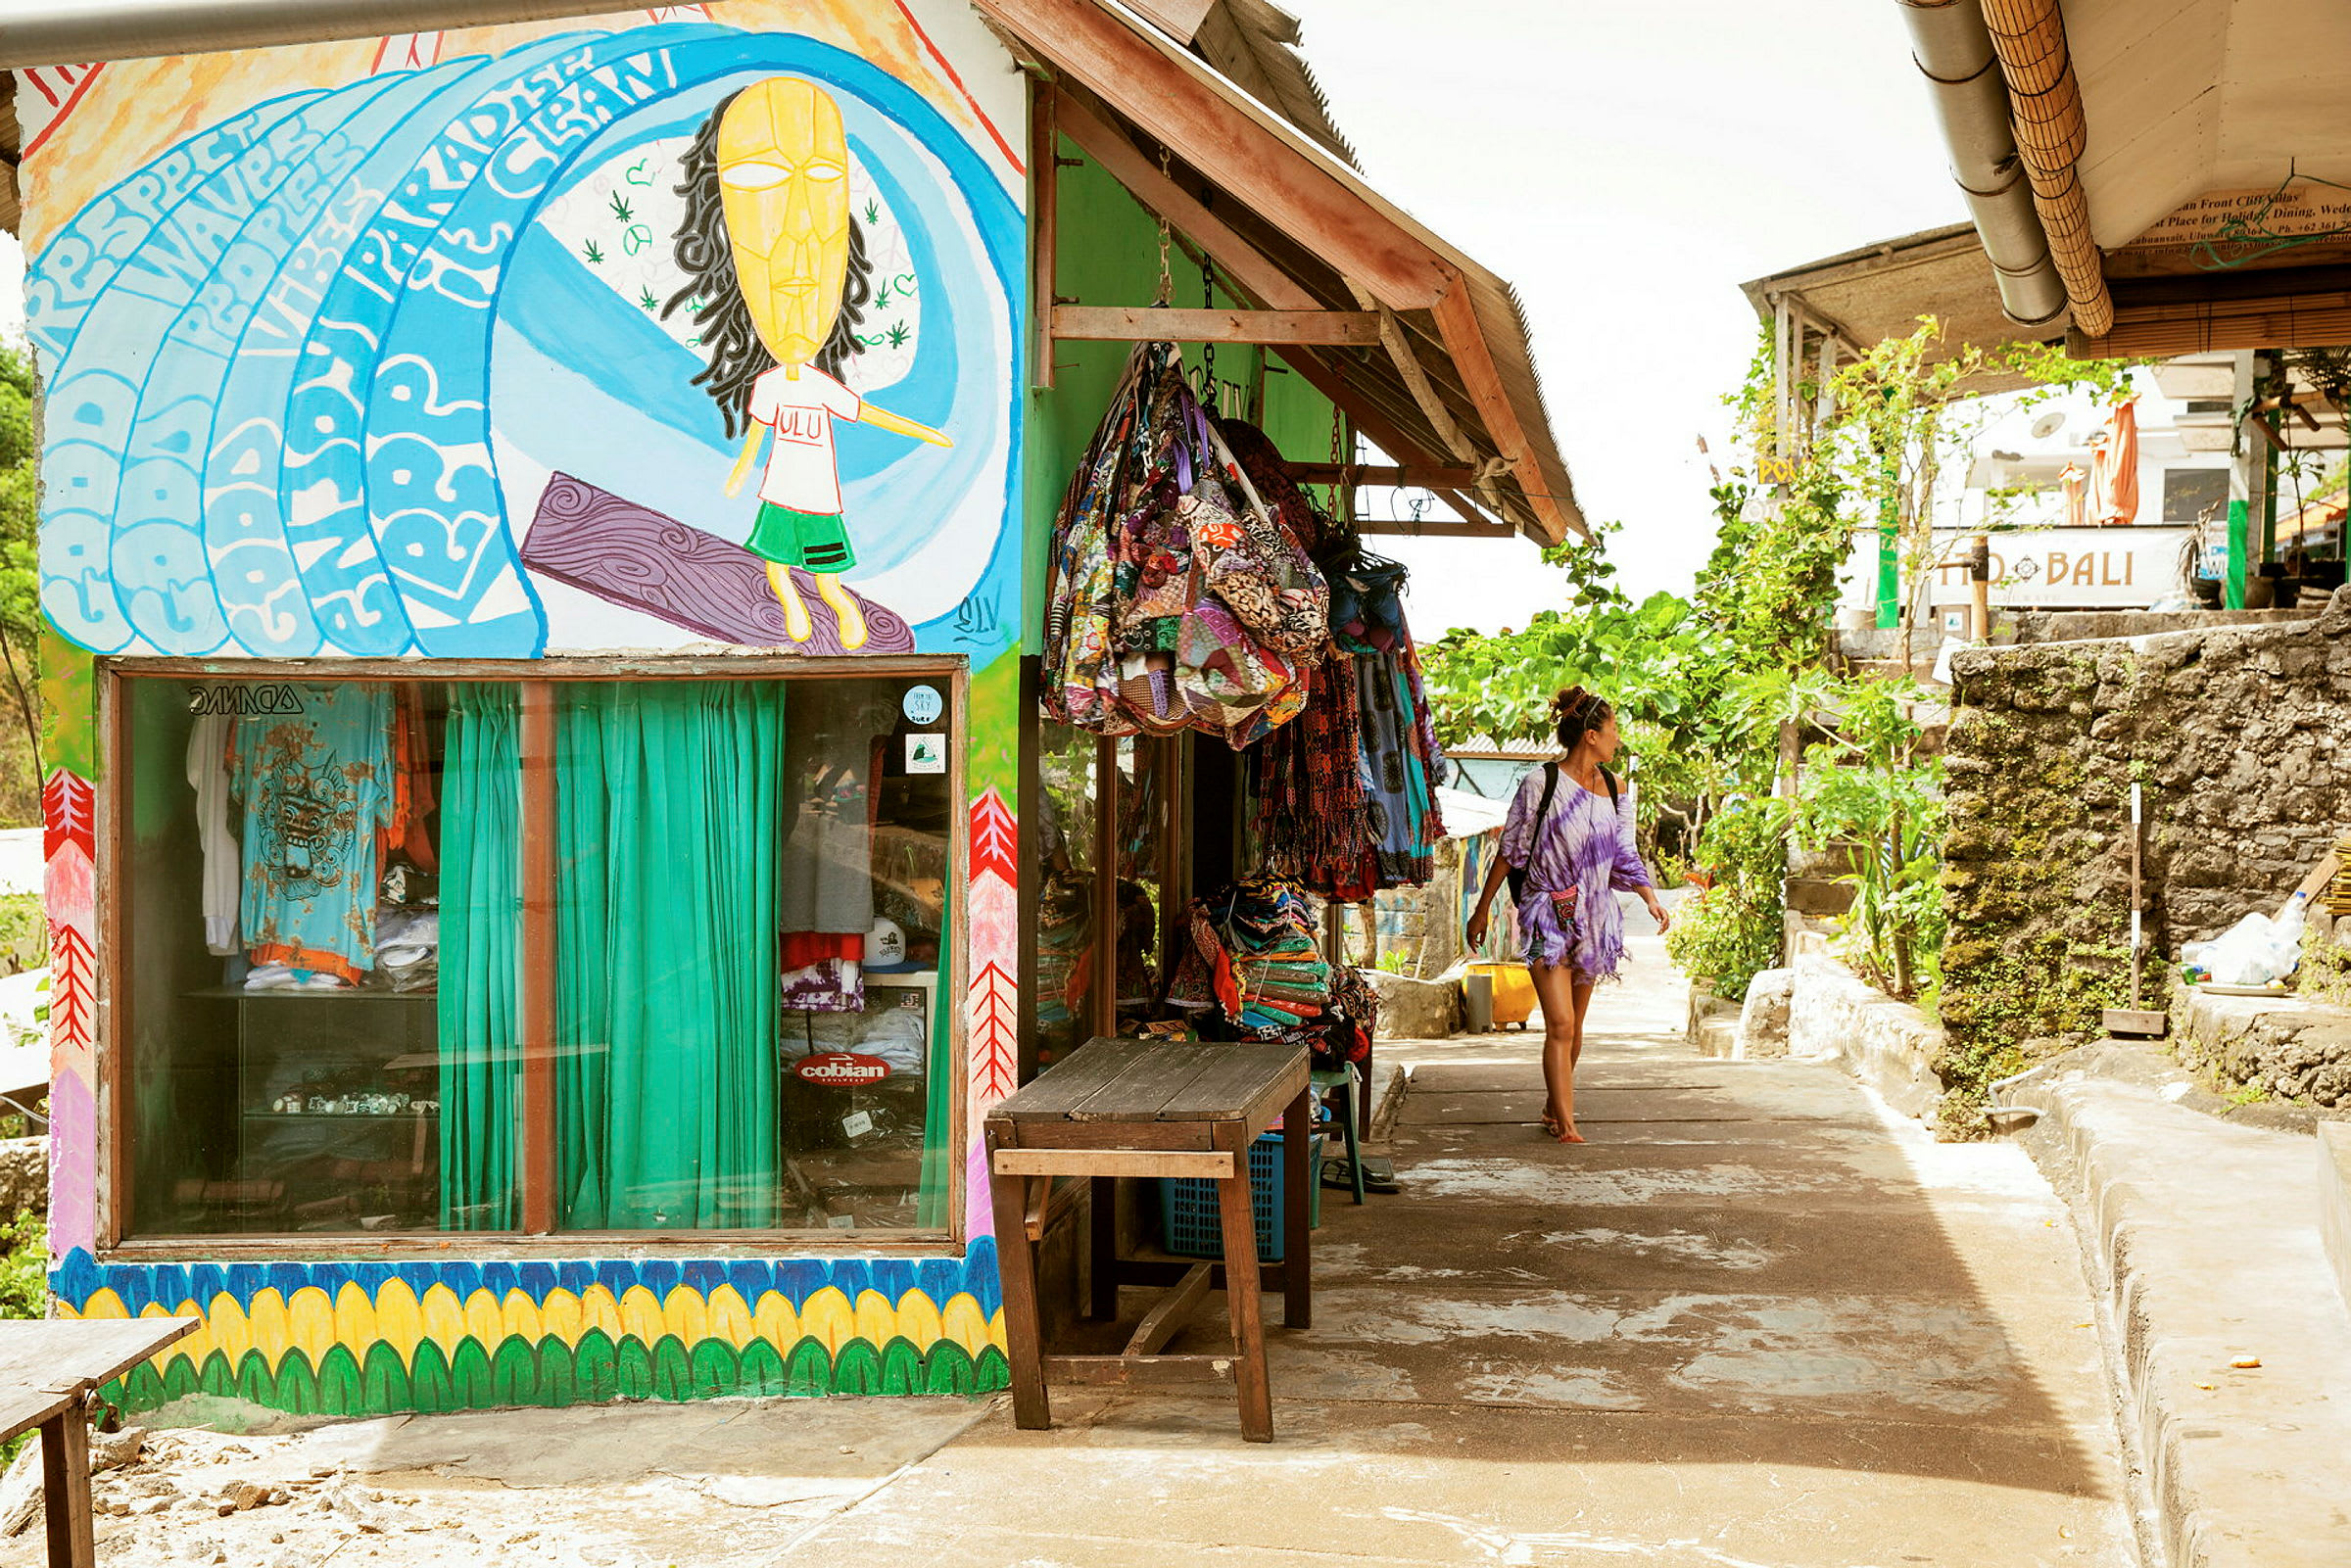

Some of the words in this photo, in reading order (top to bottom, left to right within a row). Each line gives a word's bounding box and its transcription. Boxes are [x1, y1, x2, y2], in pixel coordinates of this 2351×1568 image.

[2200, 198, 2232, 209] Front
[2168, 216, 2198, 226] Place
[2201, 214, 2218, 224] for
[779, 409, 822, 440] ULU
[2046, 551, 2134, 586] BALI
[800, 1062, 885, 1077] cobian
